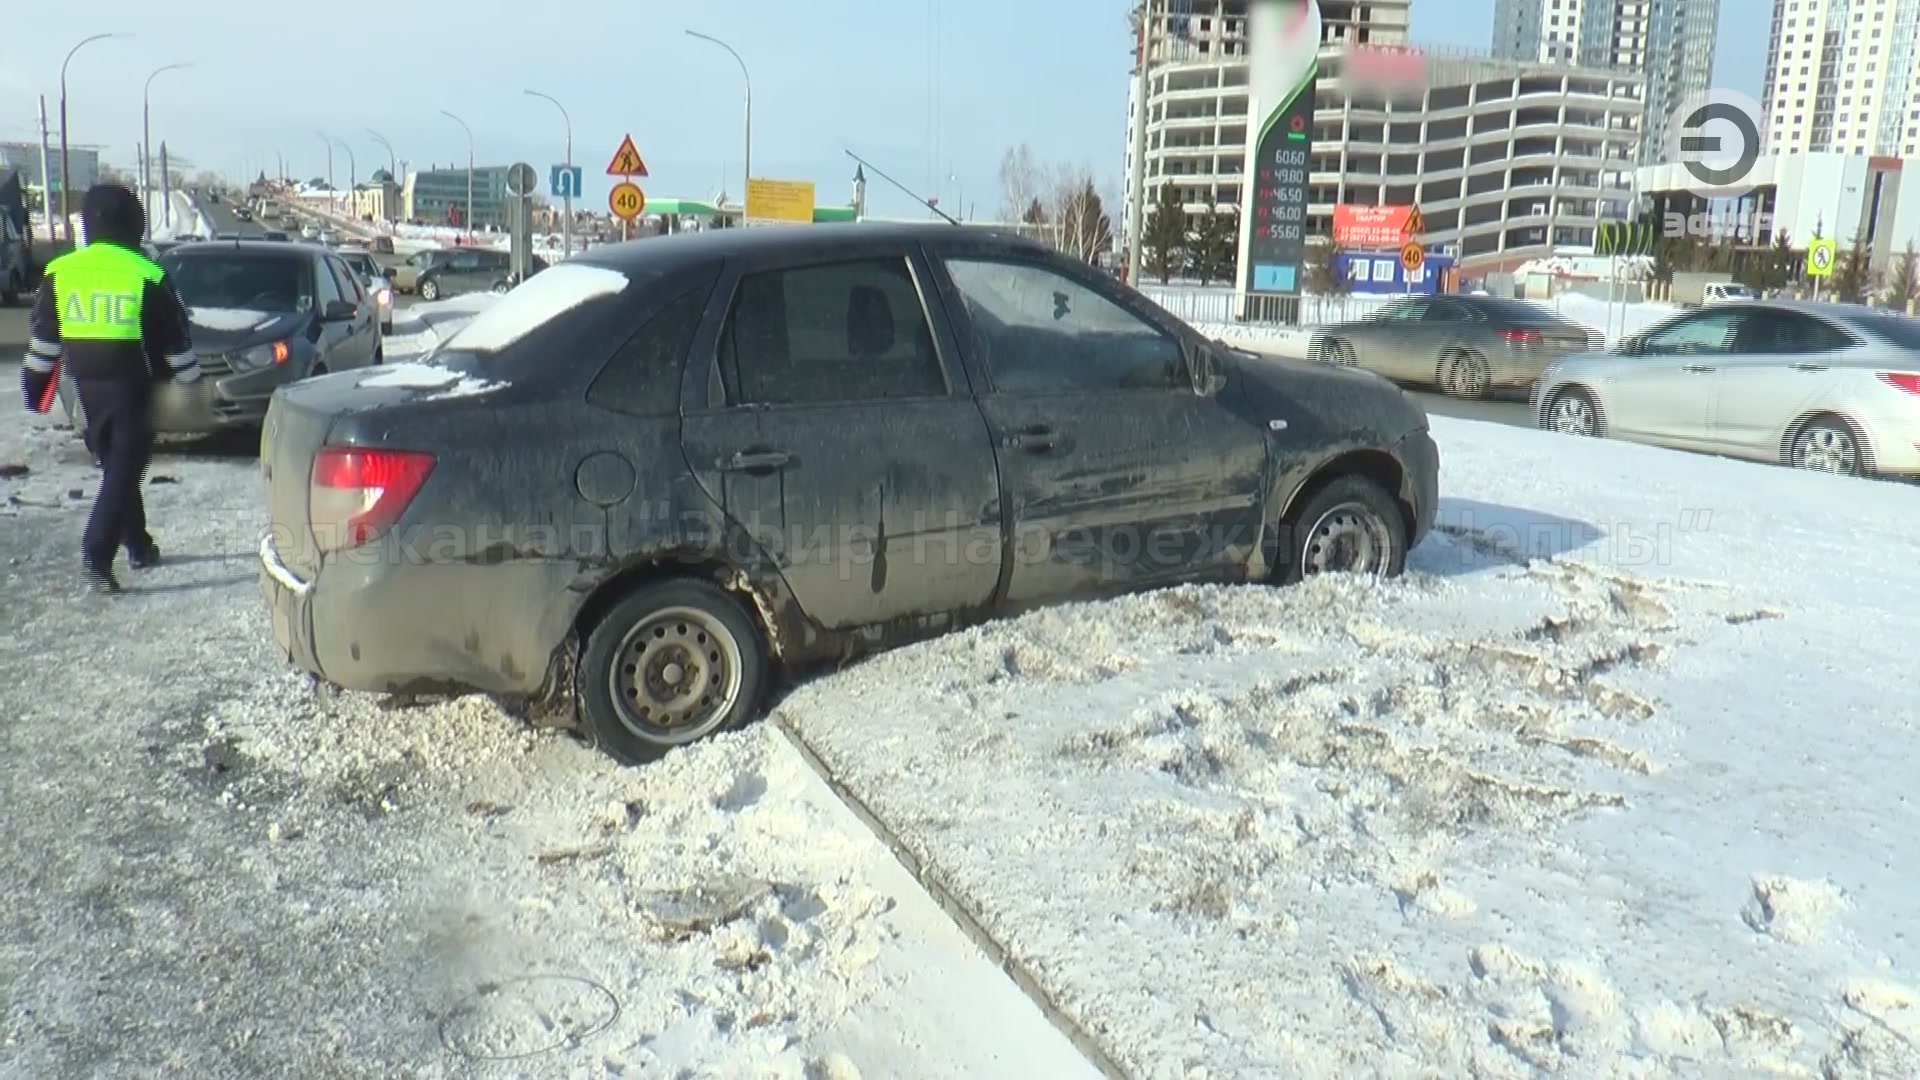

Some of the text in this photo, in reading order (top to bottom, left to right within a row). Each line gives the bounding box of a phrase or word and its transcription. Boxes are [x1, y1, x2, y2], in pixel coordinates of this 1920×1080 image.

[617, 193, 637, 209] 40
[1404, 250, 1420, 264] 40
[65, 293, 136, 325] ДПС
